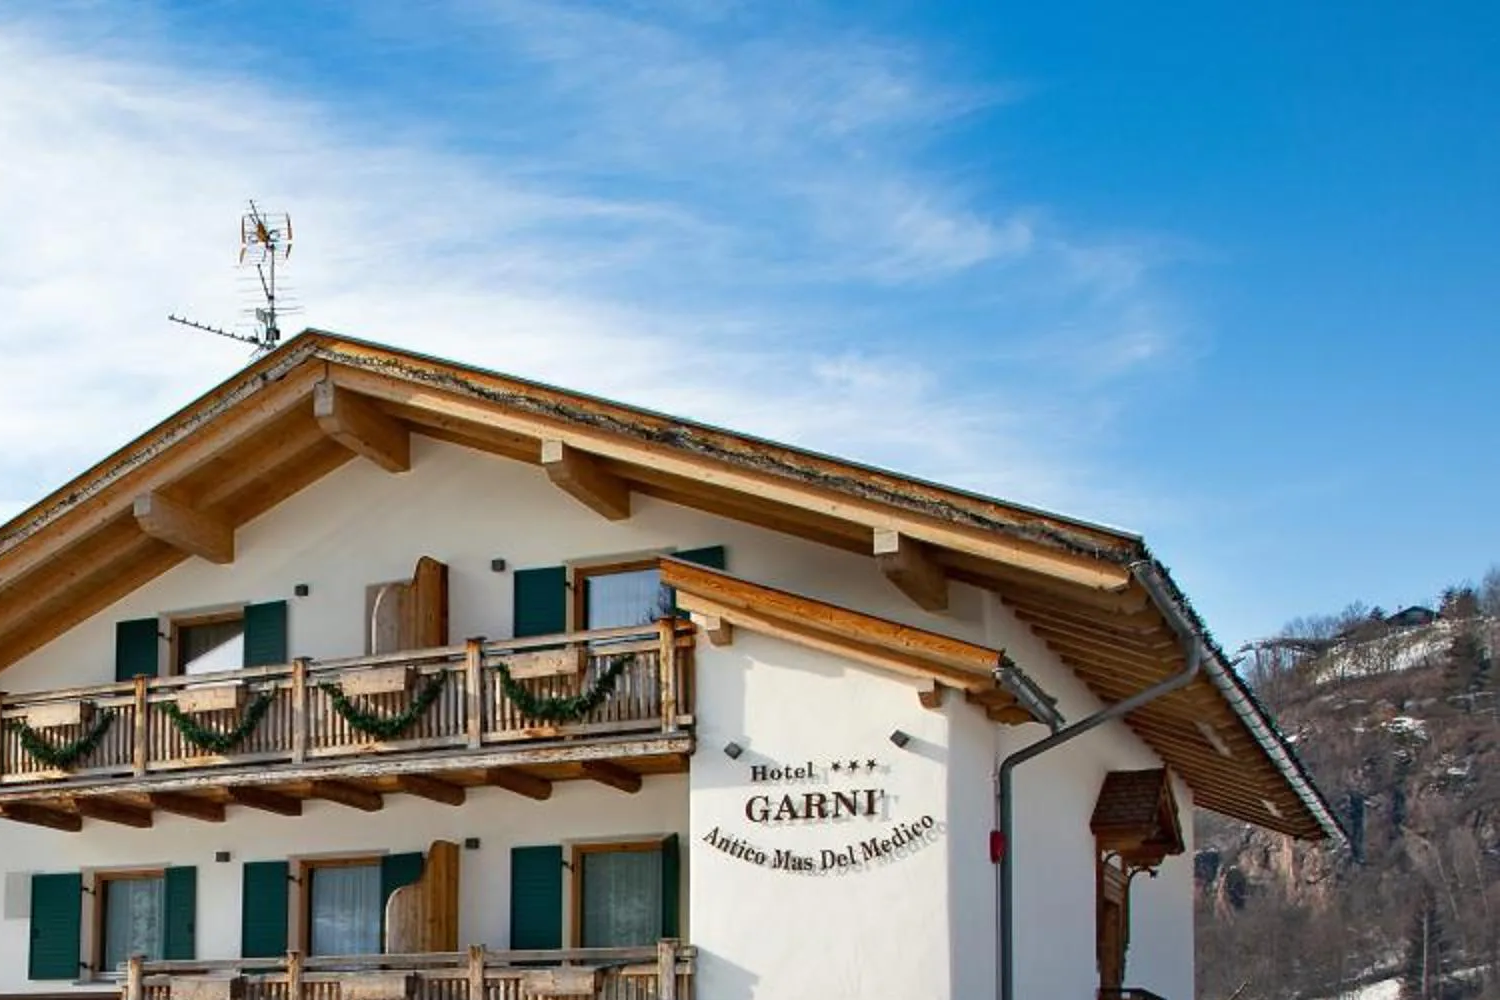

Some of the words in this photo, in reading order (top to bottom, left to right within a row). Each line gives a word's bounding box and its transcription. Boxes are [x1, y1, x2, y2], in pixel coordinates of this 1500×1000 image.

[750, 762, 814, 782] Hotel
[702, 825, 766, 865] Antico
[771, 848, 813, 872] Mas
[820, 846, 857, 871] Del
[860, 814, 935, 861] Medico
